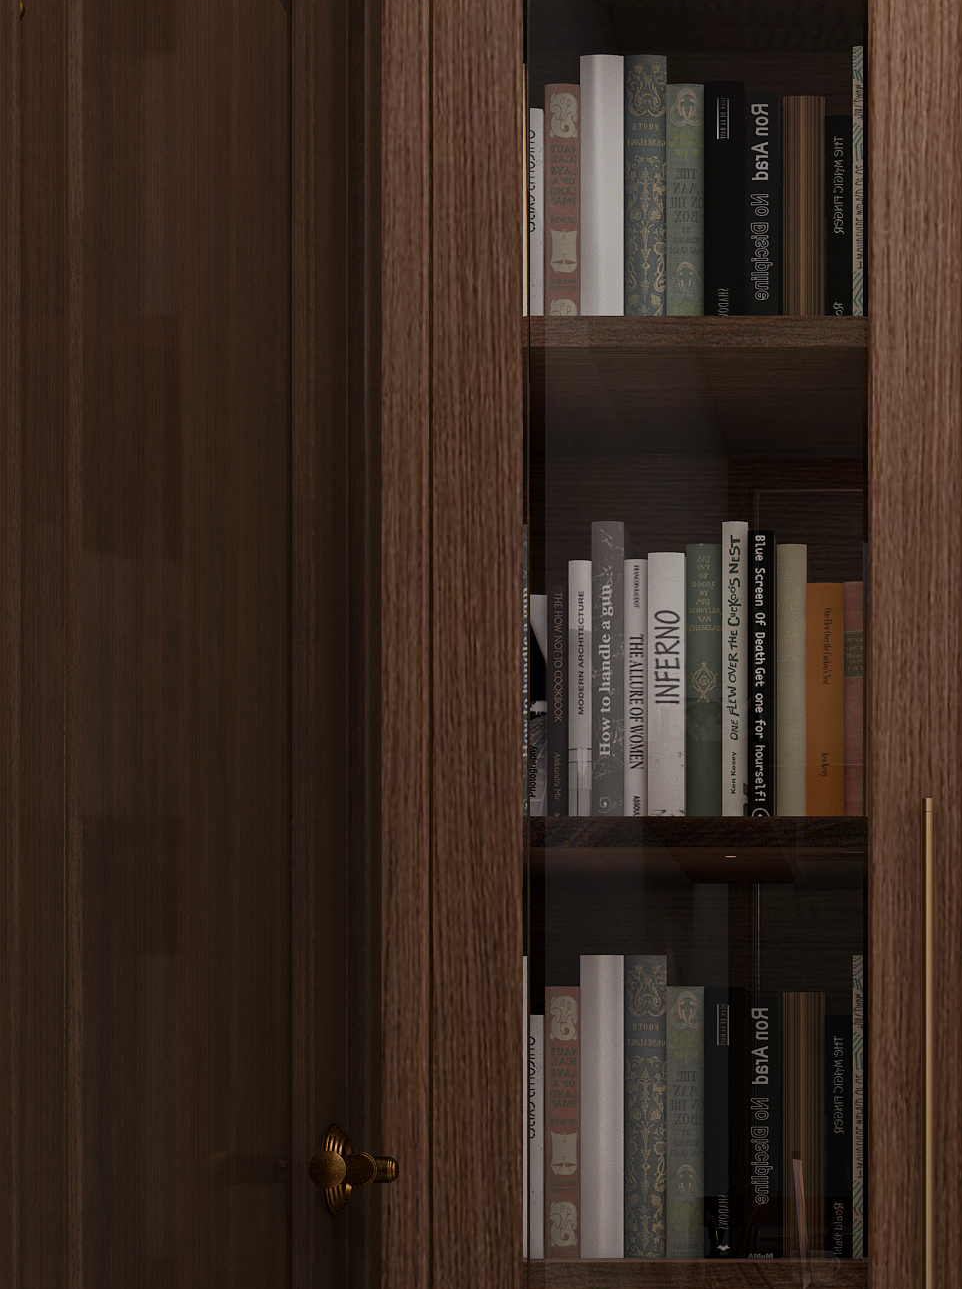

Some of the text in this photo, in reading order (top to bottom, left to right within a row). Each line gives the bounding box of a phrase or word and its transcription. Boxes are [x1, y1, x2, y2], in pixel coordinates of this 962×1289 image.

[754, 535, 766, 562] Blue
[754, 569, 766, 607] Screen
[754, 612, 766, 626] Of
[728, 535, 741, 741] ONE FLEW OVER THE NEST
[754, 632, 766, 665] Death
[553, 592, 563, 723] THE HOW NOT TO COOKBOOK
[599, 584, 614, 757] How to handle a gun
[654, 610, 680, 705] INFERNO
[754, 667, 766, 687] Get
[630, 634, 644, 769] THE ALLURE OF WOMEN
[754, 693, 764, 713] one
[754, 719, 766, 739] for
[530, 745, 538, 798] Photography
[730, 751, 738, 777] Kesey
